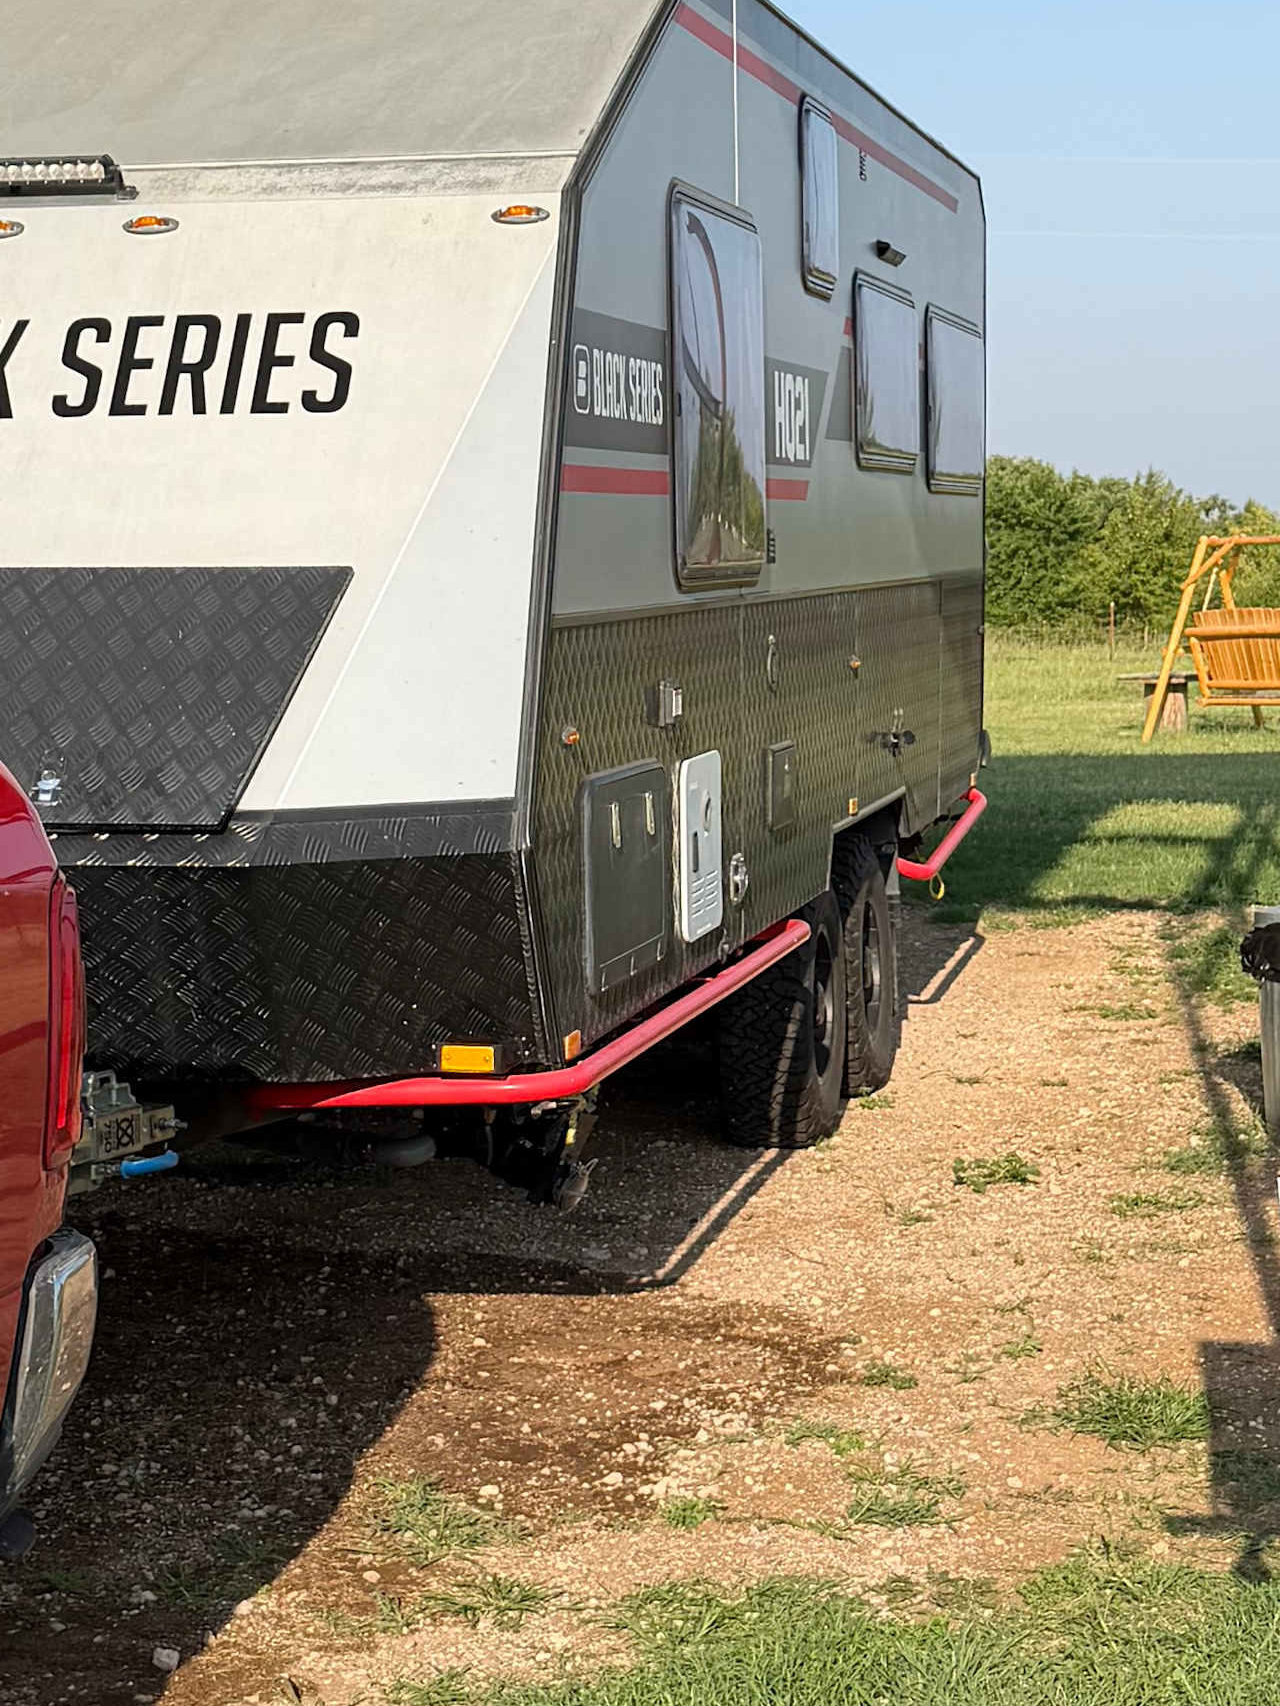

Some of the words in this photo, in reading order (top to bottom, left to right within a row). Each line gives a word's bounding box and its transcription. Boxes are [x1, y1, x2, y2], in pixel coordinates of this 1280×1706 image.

[51, 311, 360, 419] SERIES
[593, 348, 628, 420] BLACK
[628, 357, 663, 426] SERIES
[774, 370, 810, 463] HQ21
